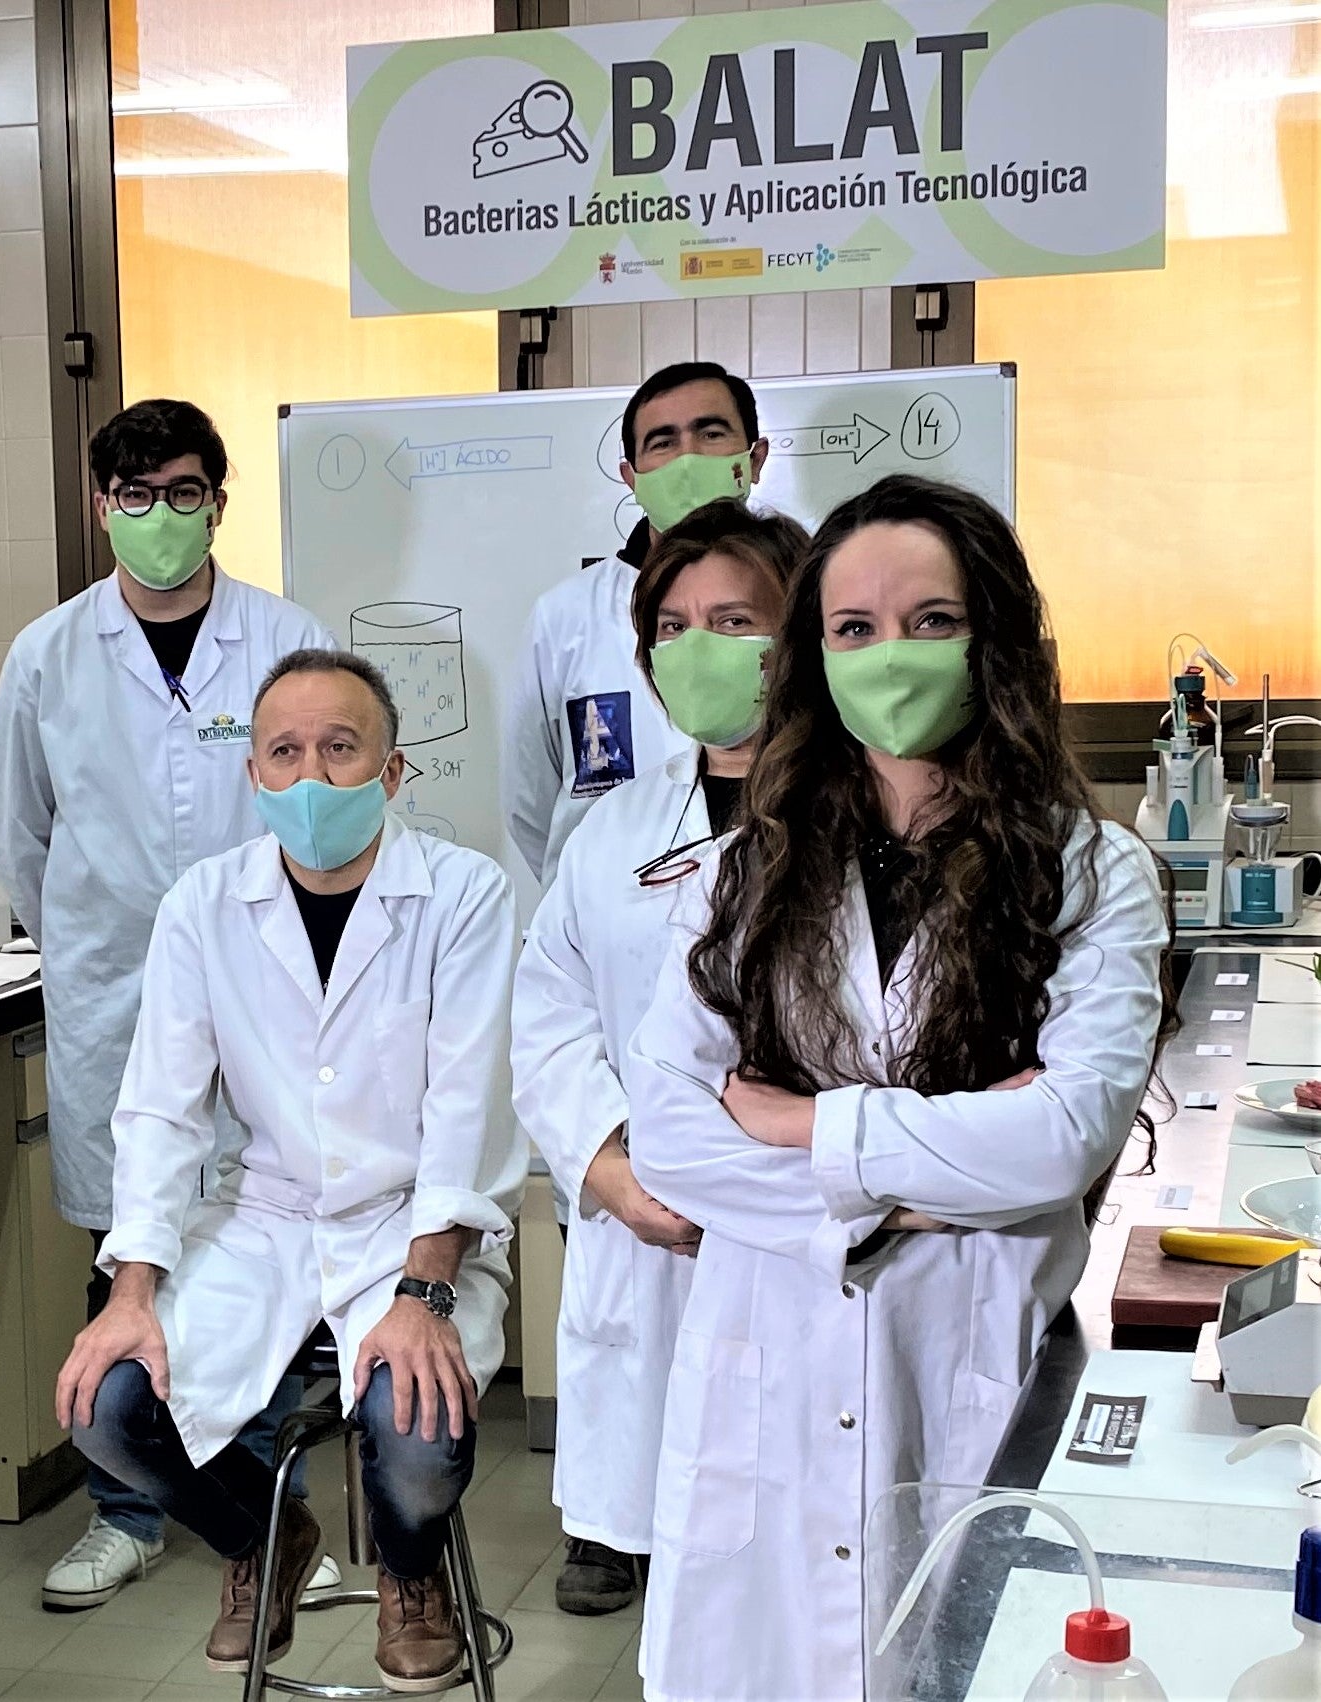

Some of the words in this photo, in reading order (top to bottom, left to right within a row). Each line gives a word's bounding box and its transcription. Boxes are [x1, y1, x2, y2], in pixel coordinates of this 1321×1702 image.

[611, 31, 989, 177] BALAT
[424, 199, 559, 237] Bacterias
[569, 190, 691, 227] Lácticas
[699, 192, 717, 226] y
[725, 173, 885, 222] Aplicación
[896, 160, 1087, 204] Tecnológica
[767, 252, 814, 268] FECYT
[917, 407, 942, 446] 14
[197, 725, 252, 741] ENTREPINARES
